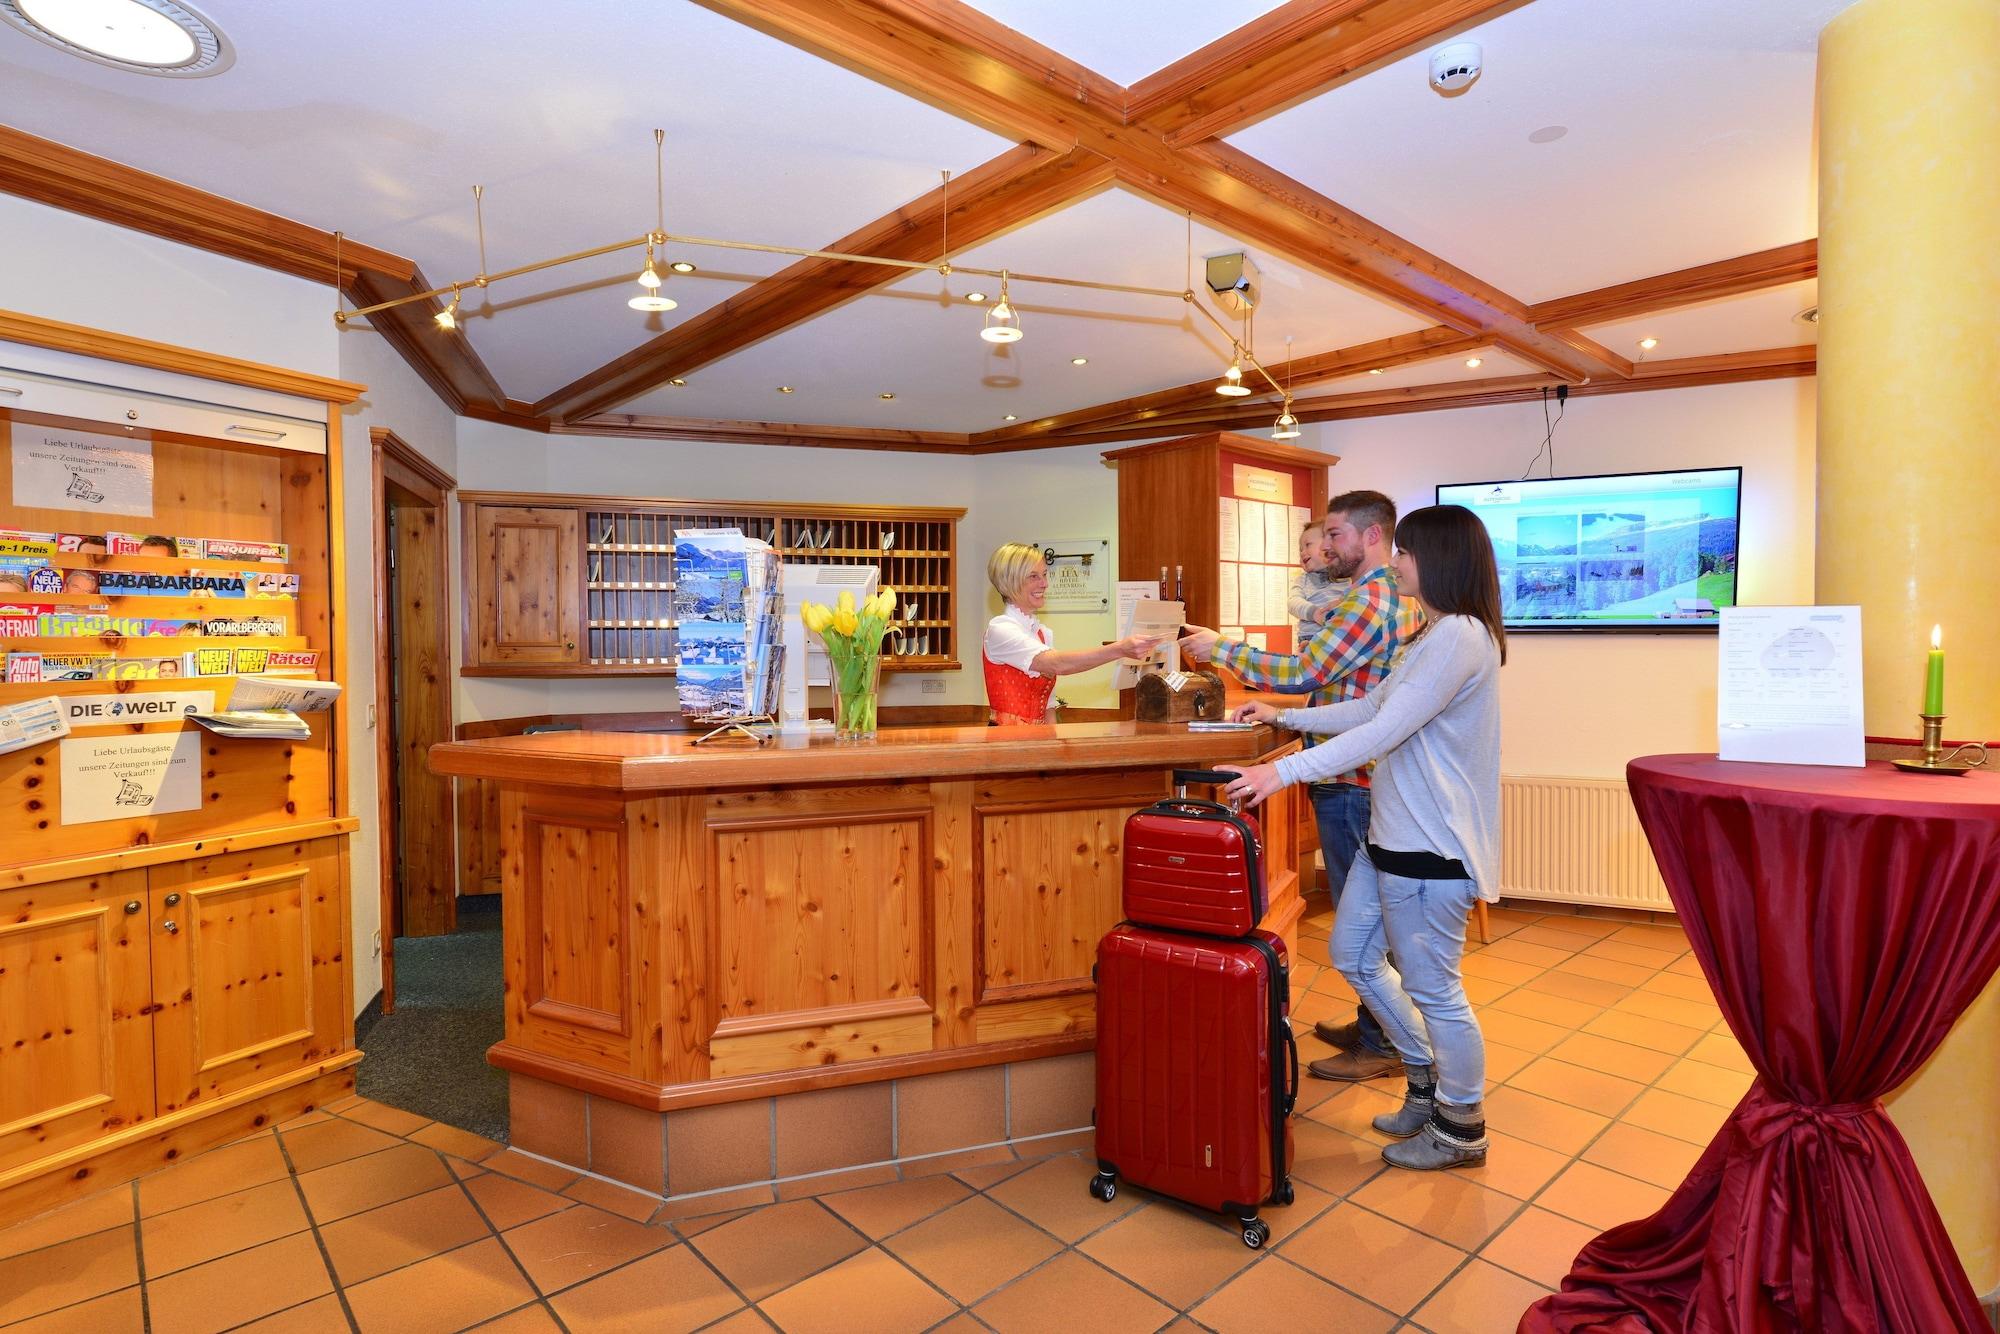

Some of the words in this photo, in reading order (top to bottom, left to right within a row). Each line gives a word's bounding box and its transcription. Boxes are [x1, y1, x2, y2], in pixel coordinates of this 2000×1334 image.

[44, 438, 68, 448] Liebe
[29, 451, 57, 460] unsere
[22, 545, 49, 554] Preis
[208, 543, 277, 557] ENQUIRER
[34, 576, 61, 586] NEUE
[33, 585, 62, 593] BLATT
[40, 615, 144, 637] Brigitte
[206, 622, 282, 633] VORARLBERGERIN
[42, 658, 69, 666] NEUER
[71, 657, 83, 666] VW
[199, 650, 230, 662] NEUE
[237, 649, 268, 662] NEUE
[267, 653, 316, 665] Rätsel
[10, 658, 39, 674] Auto
[199, 662, 229, 675] WELT
[237, 661, 266, 673] WELT
[70, 704, 102, 717] DIE
[94, 746, 117, 757] Liebe
[79, 764, 107, 773] unsere
[109, 761, 150, 771] Zeitungen
[151, 758, 168, 766] sind
[170, 757, 187, 765] zum
